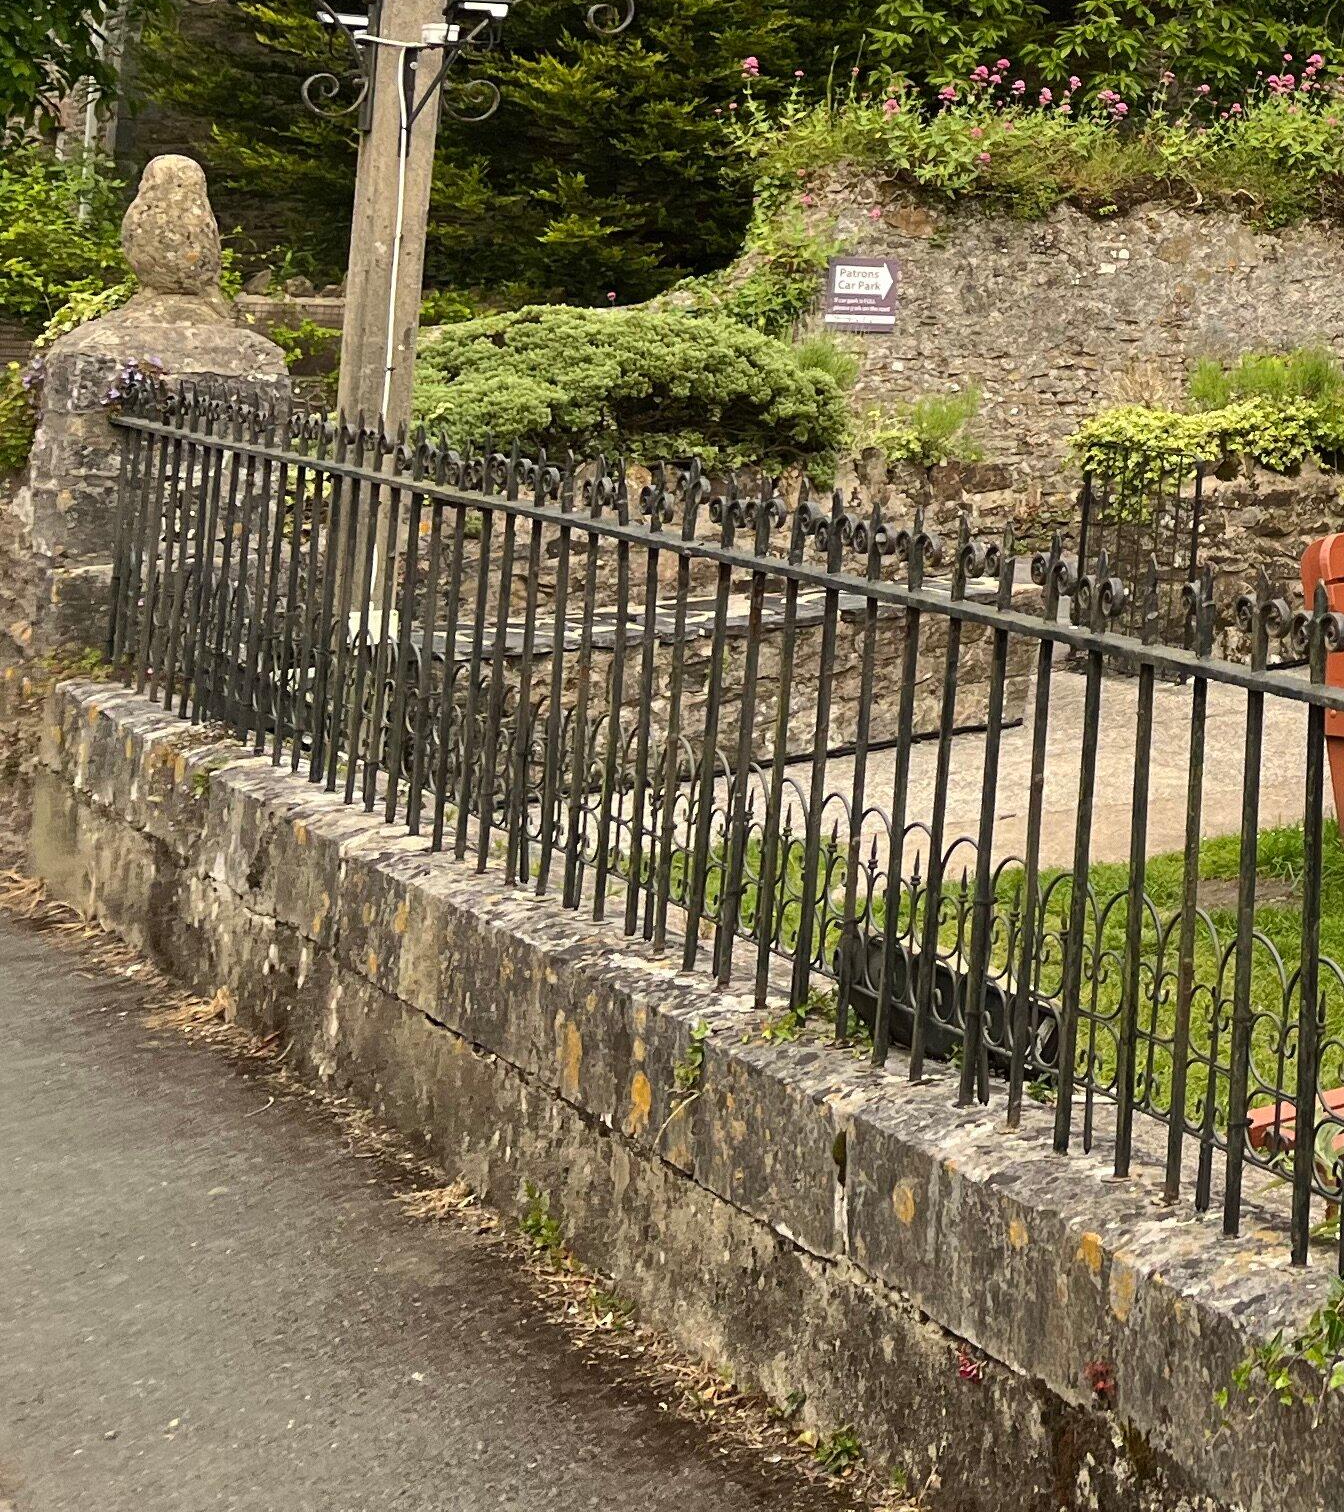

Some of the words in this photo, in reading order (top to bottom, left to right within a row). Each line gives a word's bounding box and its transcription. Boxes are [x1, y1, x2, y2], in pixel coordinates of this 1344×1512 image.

[840, 268, 880, 278] Patrons
[838, 280, 856, 290] Car
[858, 281, 881, 291] Park
